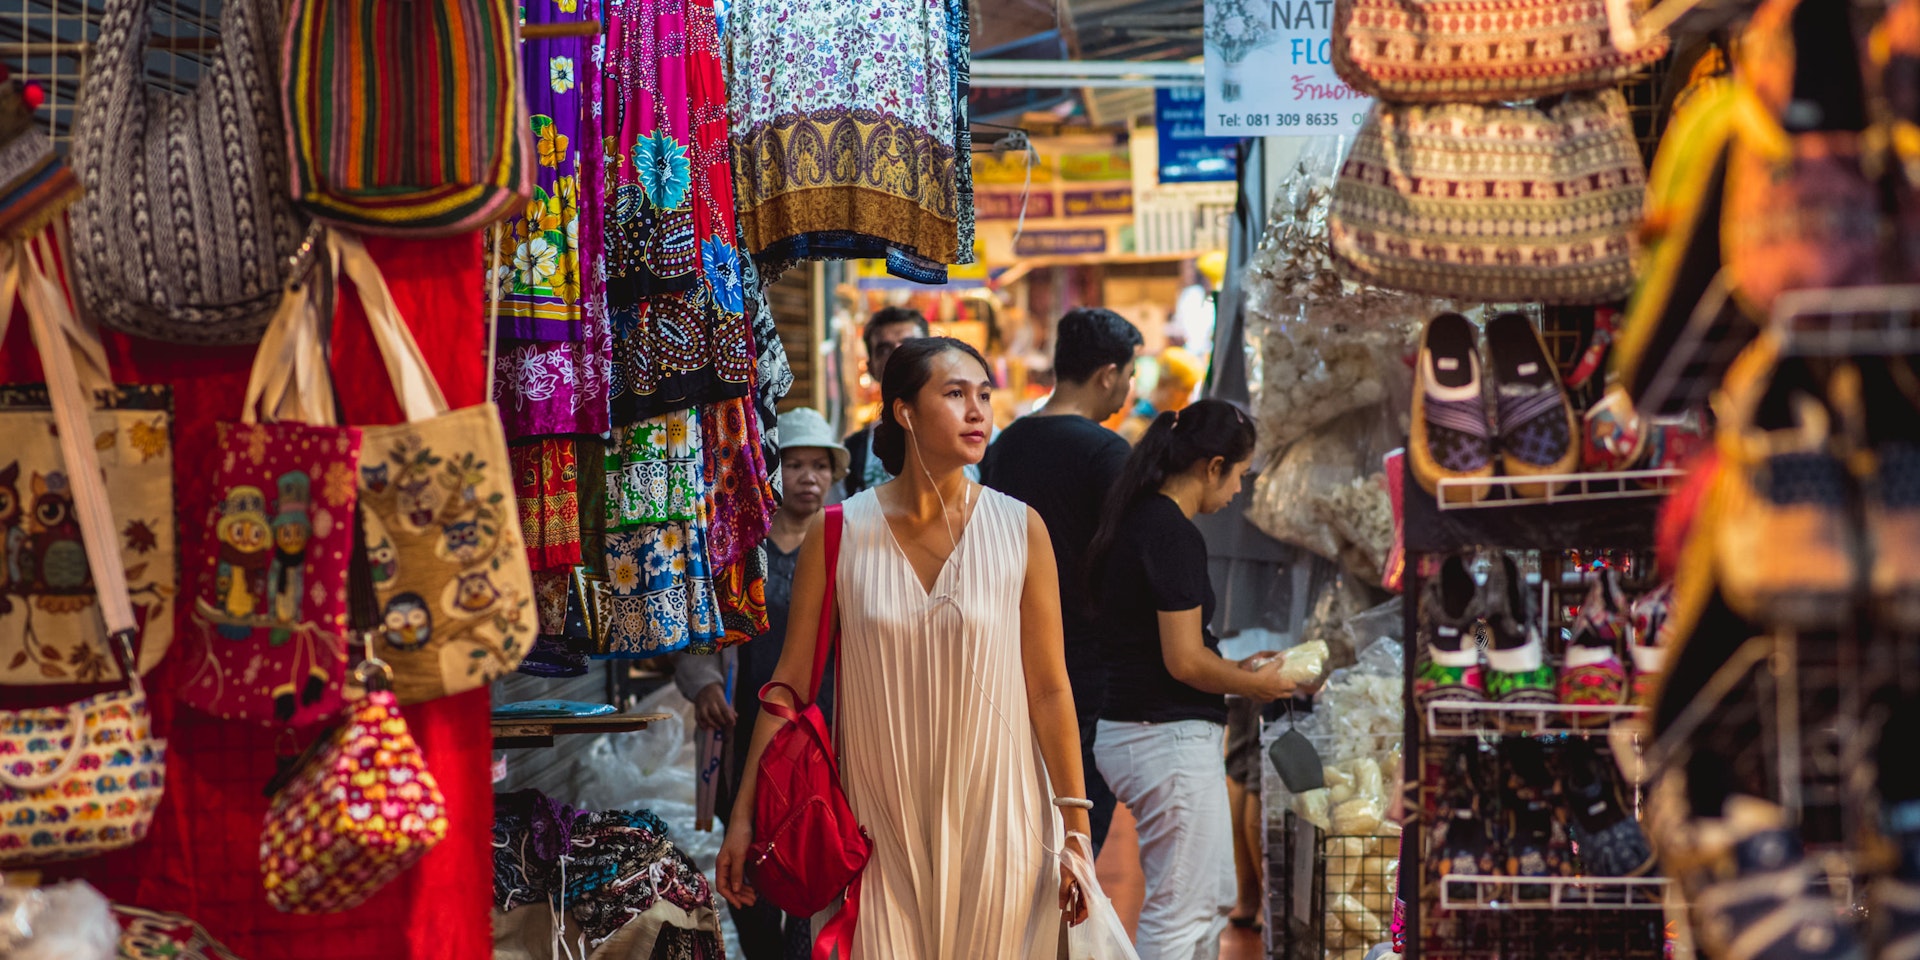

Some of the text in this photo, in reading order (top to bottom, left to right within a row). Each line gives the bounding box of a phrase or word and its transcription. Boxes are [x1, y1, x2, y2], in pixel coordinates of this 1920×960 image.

[1218, 113, 1241, 127] Tel:
[1246, 113, 1270, 127] 081
[1276, 113, 1301, 127] 309
[1305, 112, 1339, 126] 8635
